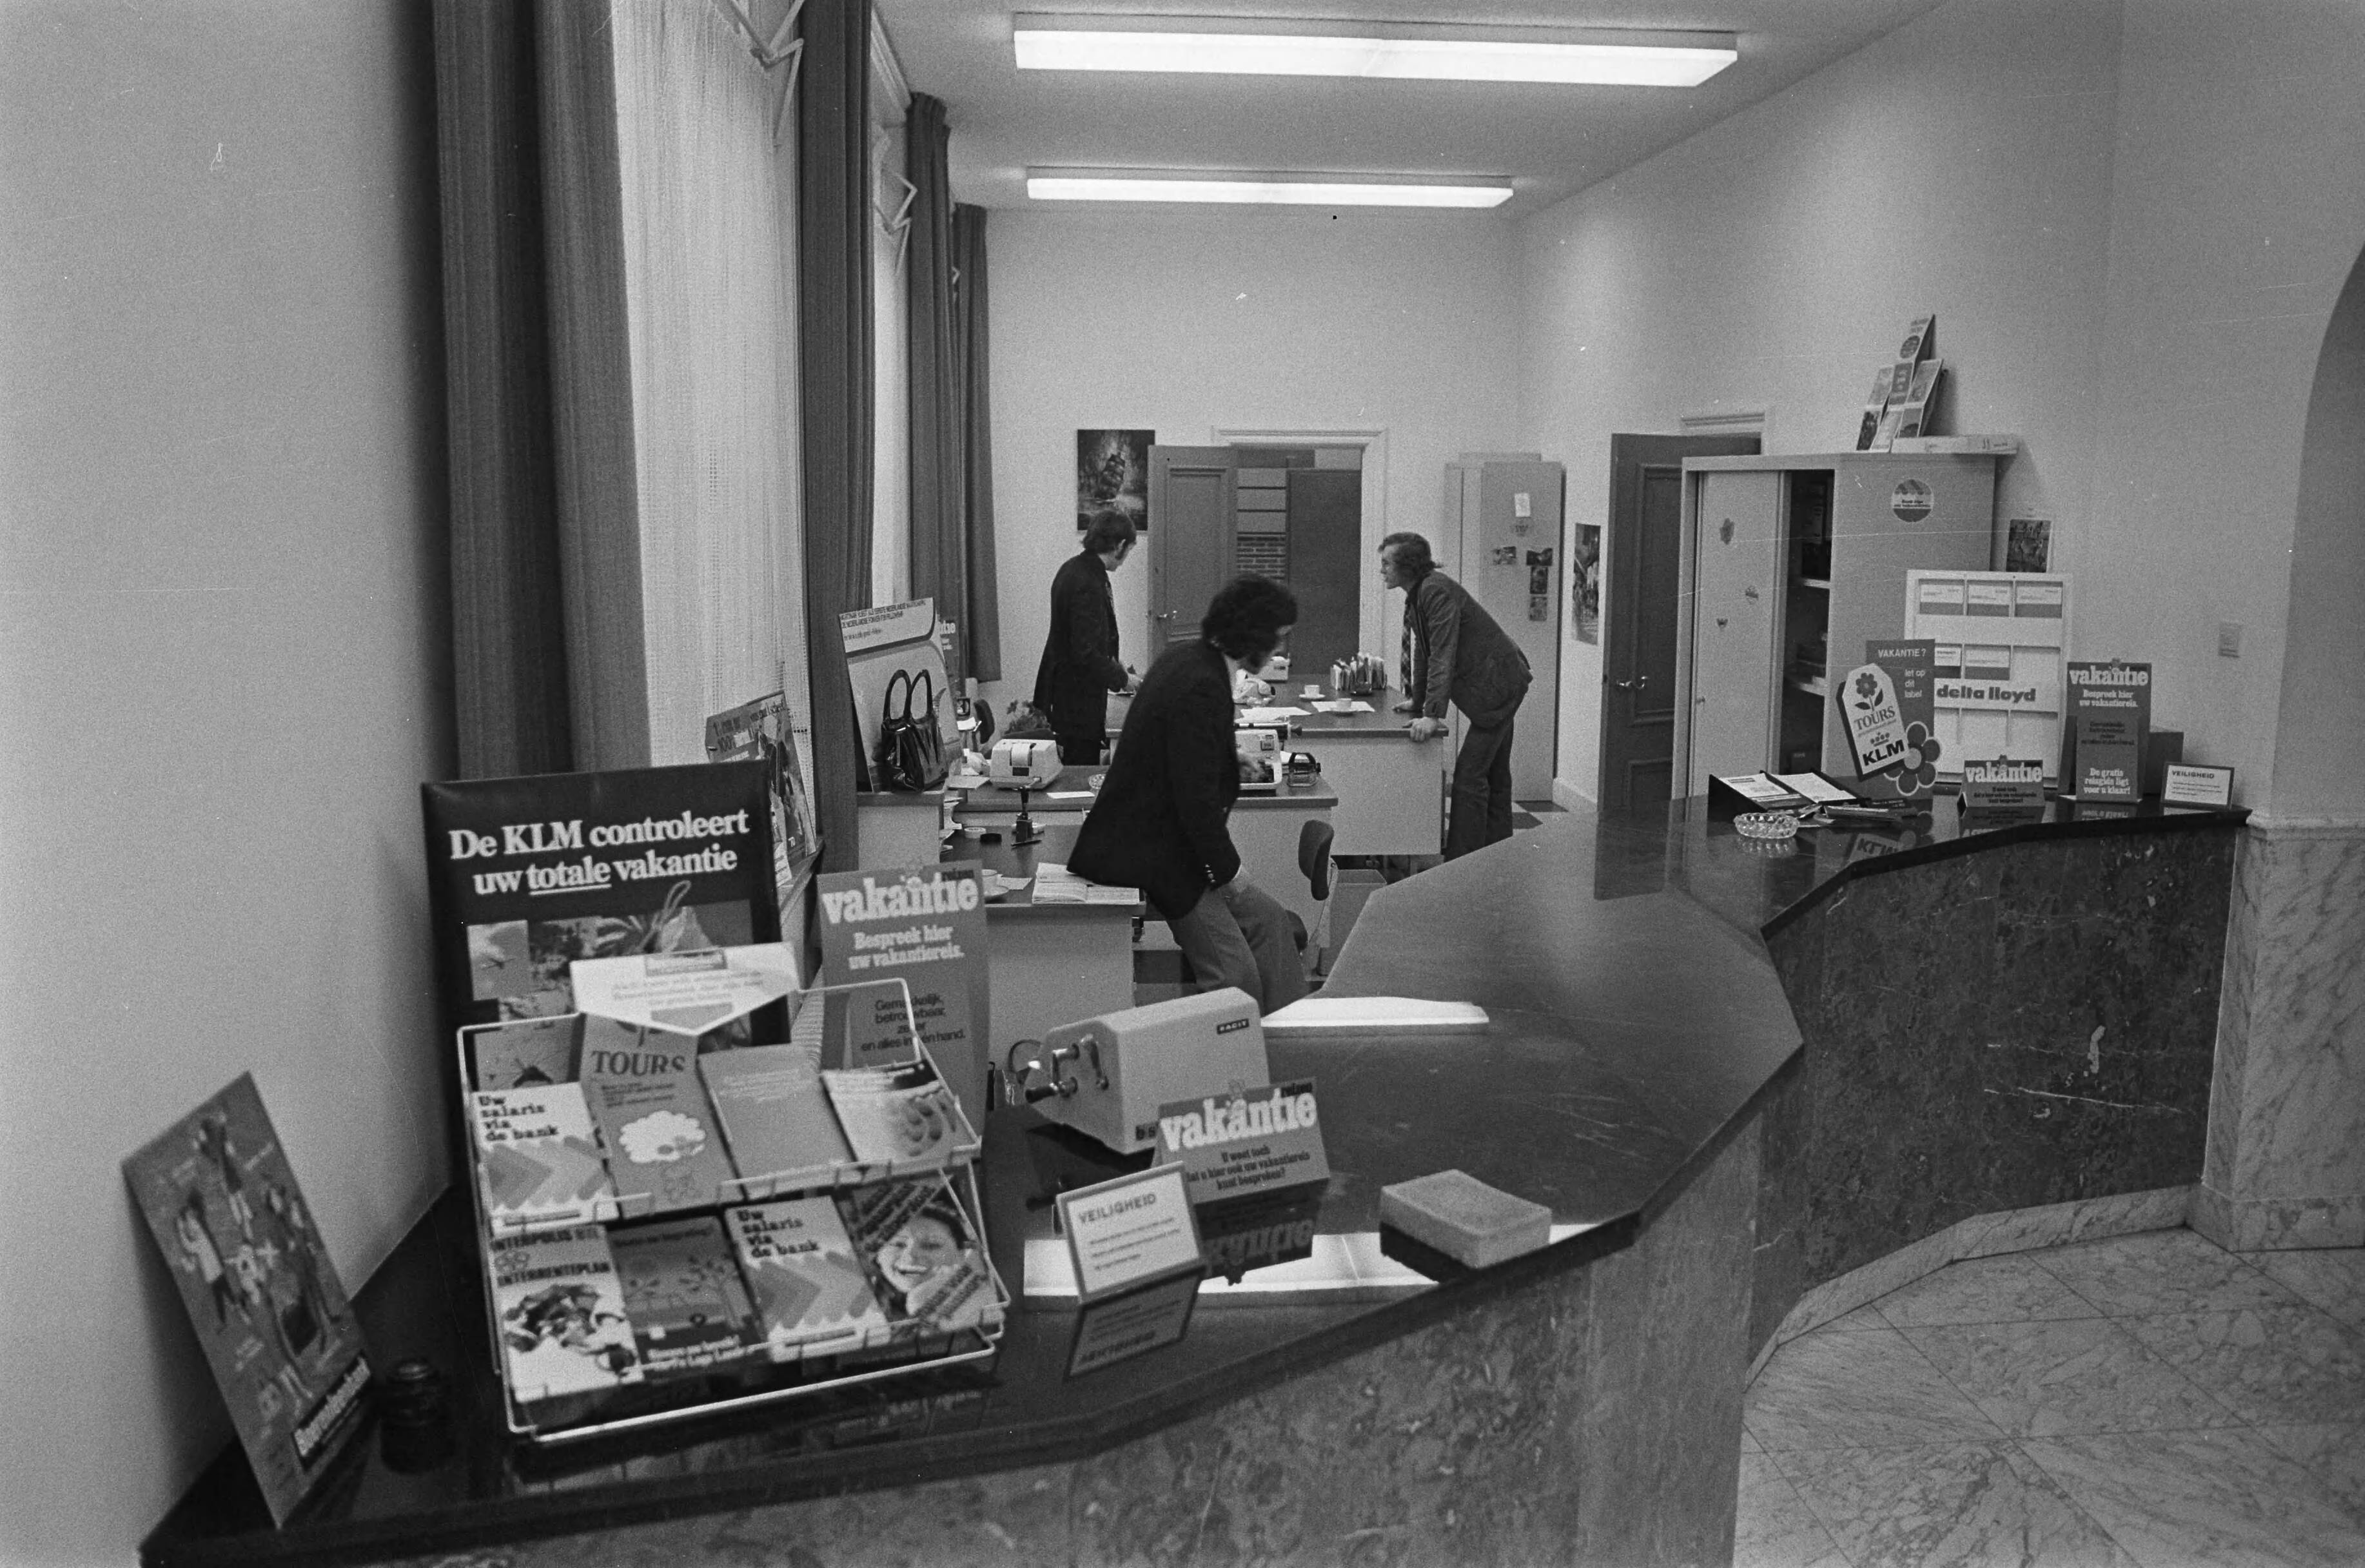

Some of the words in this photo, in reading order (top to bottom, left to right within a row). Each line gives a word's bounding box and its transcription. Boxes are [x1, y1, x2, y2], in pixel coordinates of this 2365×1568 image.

[1905, 679, 1915, 687] dit
[2069, 665, 2148, 686] vakantie
[1904, 689, 1922, 698] label
[1936, 684, 1985, 700] delta
[1988, 687, 2036, 703] lloyd
[2118, 690, 2134, 698] hier
[1854, 705, 1896, 730] TOURS
[1862, 739, 1905, 766] KLM
[1965, 761, 2043, 783] vakantie
[2101, 769, 2124, 777] gratis
[2172, 770, 2215, 779] VEILIGHEID
[449, 828, 496, 859] De
[502, 819, 583, 854] KLM
[589, 808, 749, 847] controleert
[473, 870, 523, 895] uw
[528, 855, 611, 891] totale
[613, 843, 738, 882] vakantie
[821, 872, 979, 924] vakantie
[854, 926, 921, 950] Bespreek
[923, 925, 954, 941] hier
[849, 955, 870, 970] uw
[591, 1050, 685, 1076] TOURS
[478, 1096, 506, 1106] Uw
[481, 1103, 545, 1117] salaris
[484, 1119, 511, 1130] via
[1160, 1087, 1317, 1152] vakantie
[486, 1130, 507, 1141] de
[513, 1125, 559, 1139] bank
[1221, 1152, 1228, 1162] U
[1230, 1150, 1250, 1161] weet
[1251, 1145, 1270, 1158] toch
[1201, 1171, 1207, 1181] u
[1208, 1166, 1225, 1178] hier
[1227, 1162, 1243, 1174] ook
[1244, 1162, 1257, 1171] uw
[1216, 1177, 1236, 1190] kunt
[1238, 1166, 1285, 1186] bespreken?
[737, 1210, 763, 1221] Uw
[1079, 1193, 1155, 1222] VEILIGHEID
[742, 1217, 803, 1233] salaris
[747, 1235, 773, 1245] via
[752, 1246, 771, 1257] de
[776, 1240, 819, 1255] bank
